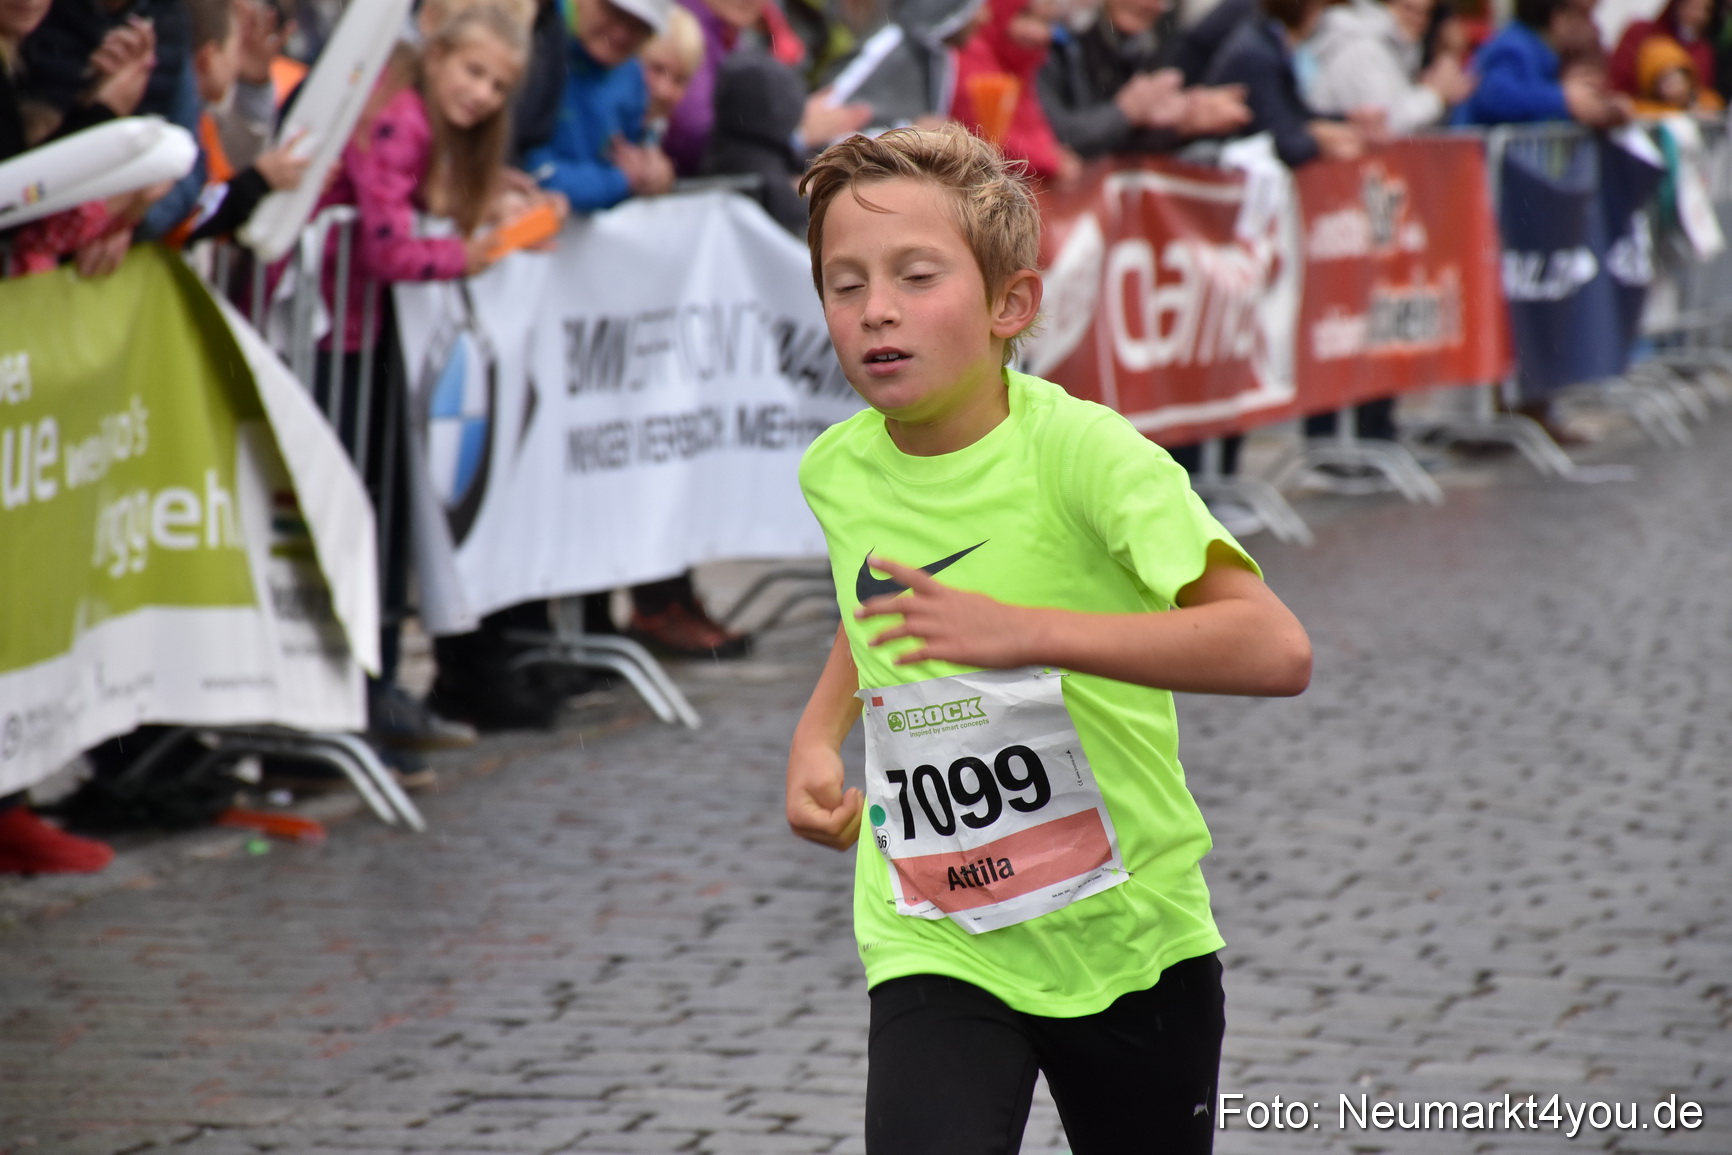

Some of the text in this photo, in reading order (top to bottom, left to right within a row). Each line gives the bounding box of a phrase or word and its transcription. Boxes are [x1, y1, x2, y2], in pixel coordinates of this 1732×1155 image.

[905, 696, 987, 730] BOCK
[909, 718, 990, 738] inspired by smart concepts
[885, 745, 1051, 840] 7099
[947, 855, 1015, 891] Attila
